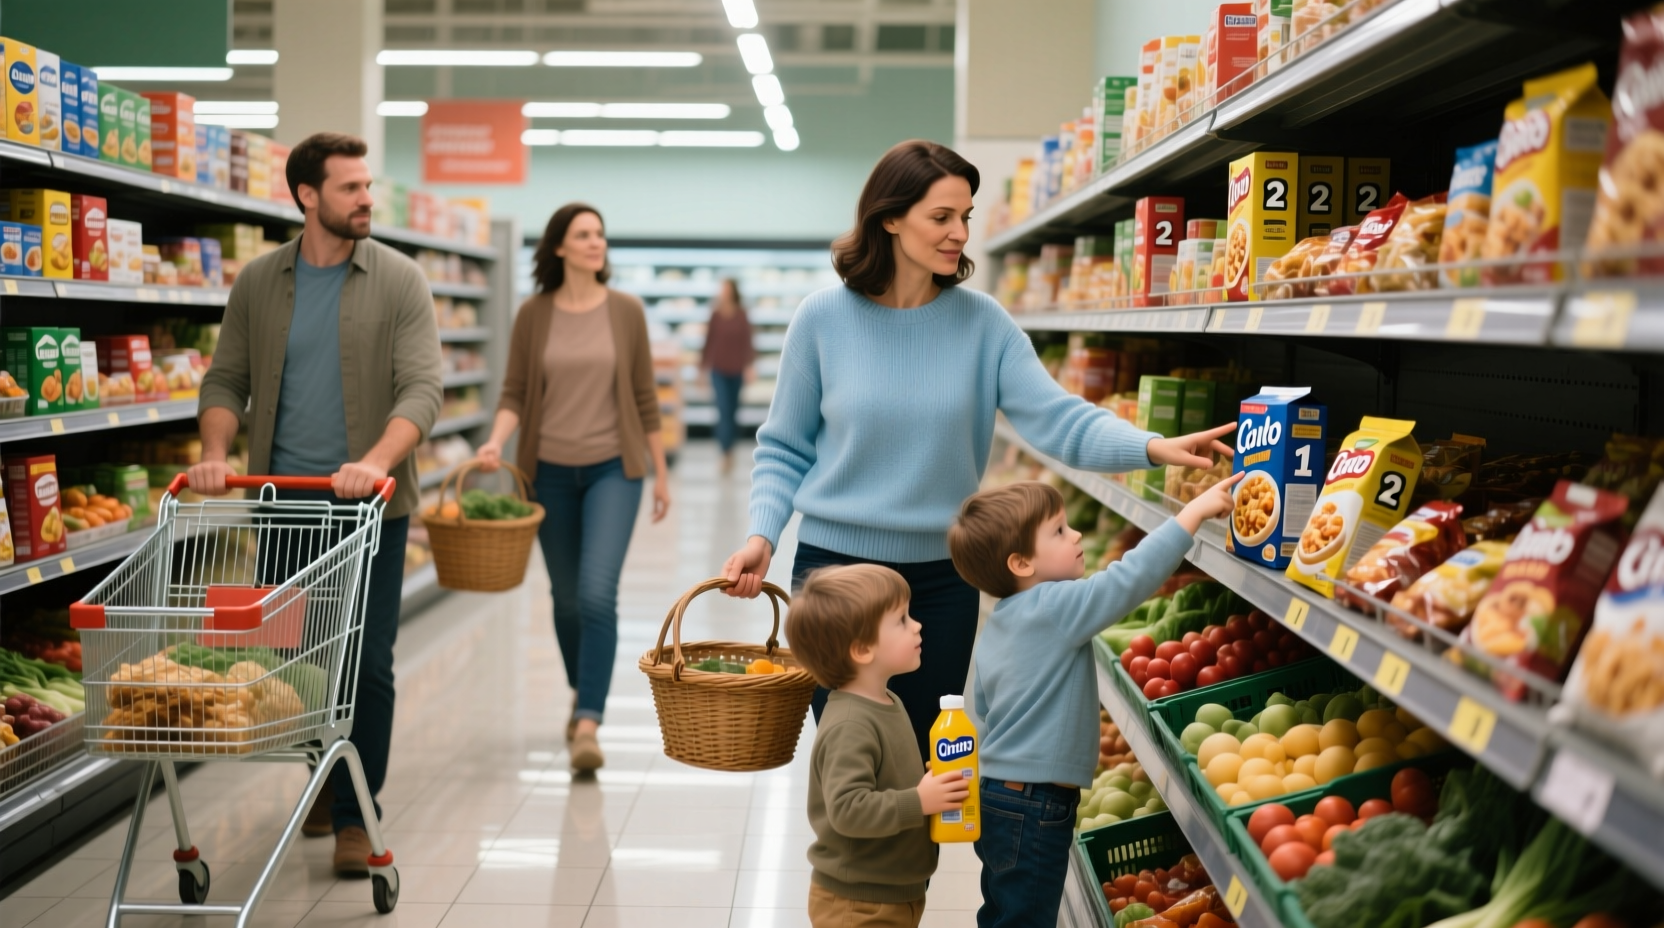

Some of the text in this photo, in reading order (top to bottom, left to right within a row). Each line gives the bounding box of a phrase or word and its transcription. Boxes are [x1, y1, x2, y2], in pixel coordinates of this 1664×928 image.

[1265, 180, 1285, 208] 2
[1310, 184, 1330, 211] 2
[1357, 185, 1378, 212] 2
[1155, 220, 1173, 246] 2
[1294, 444, 1313, 477] 1
[1378, 474, 1402, 507] 2
